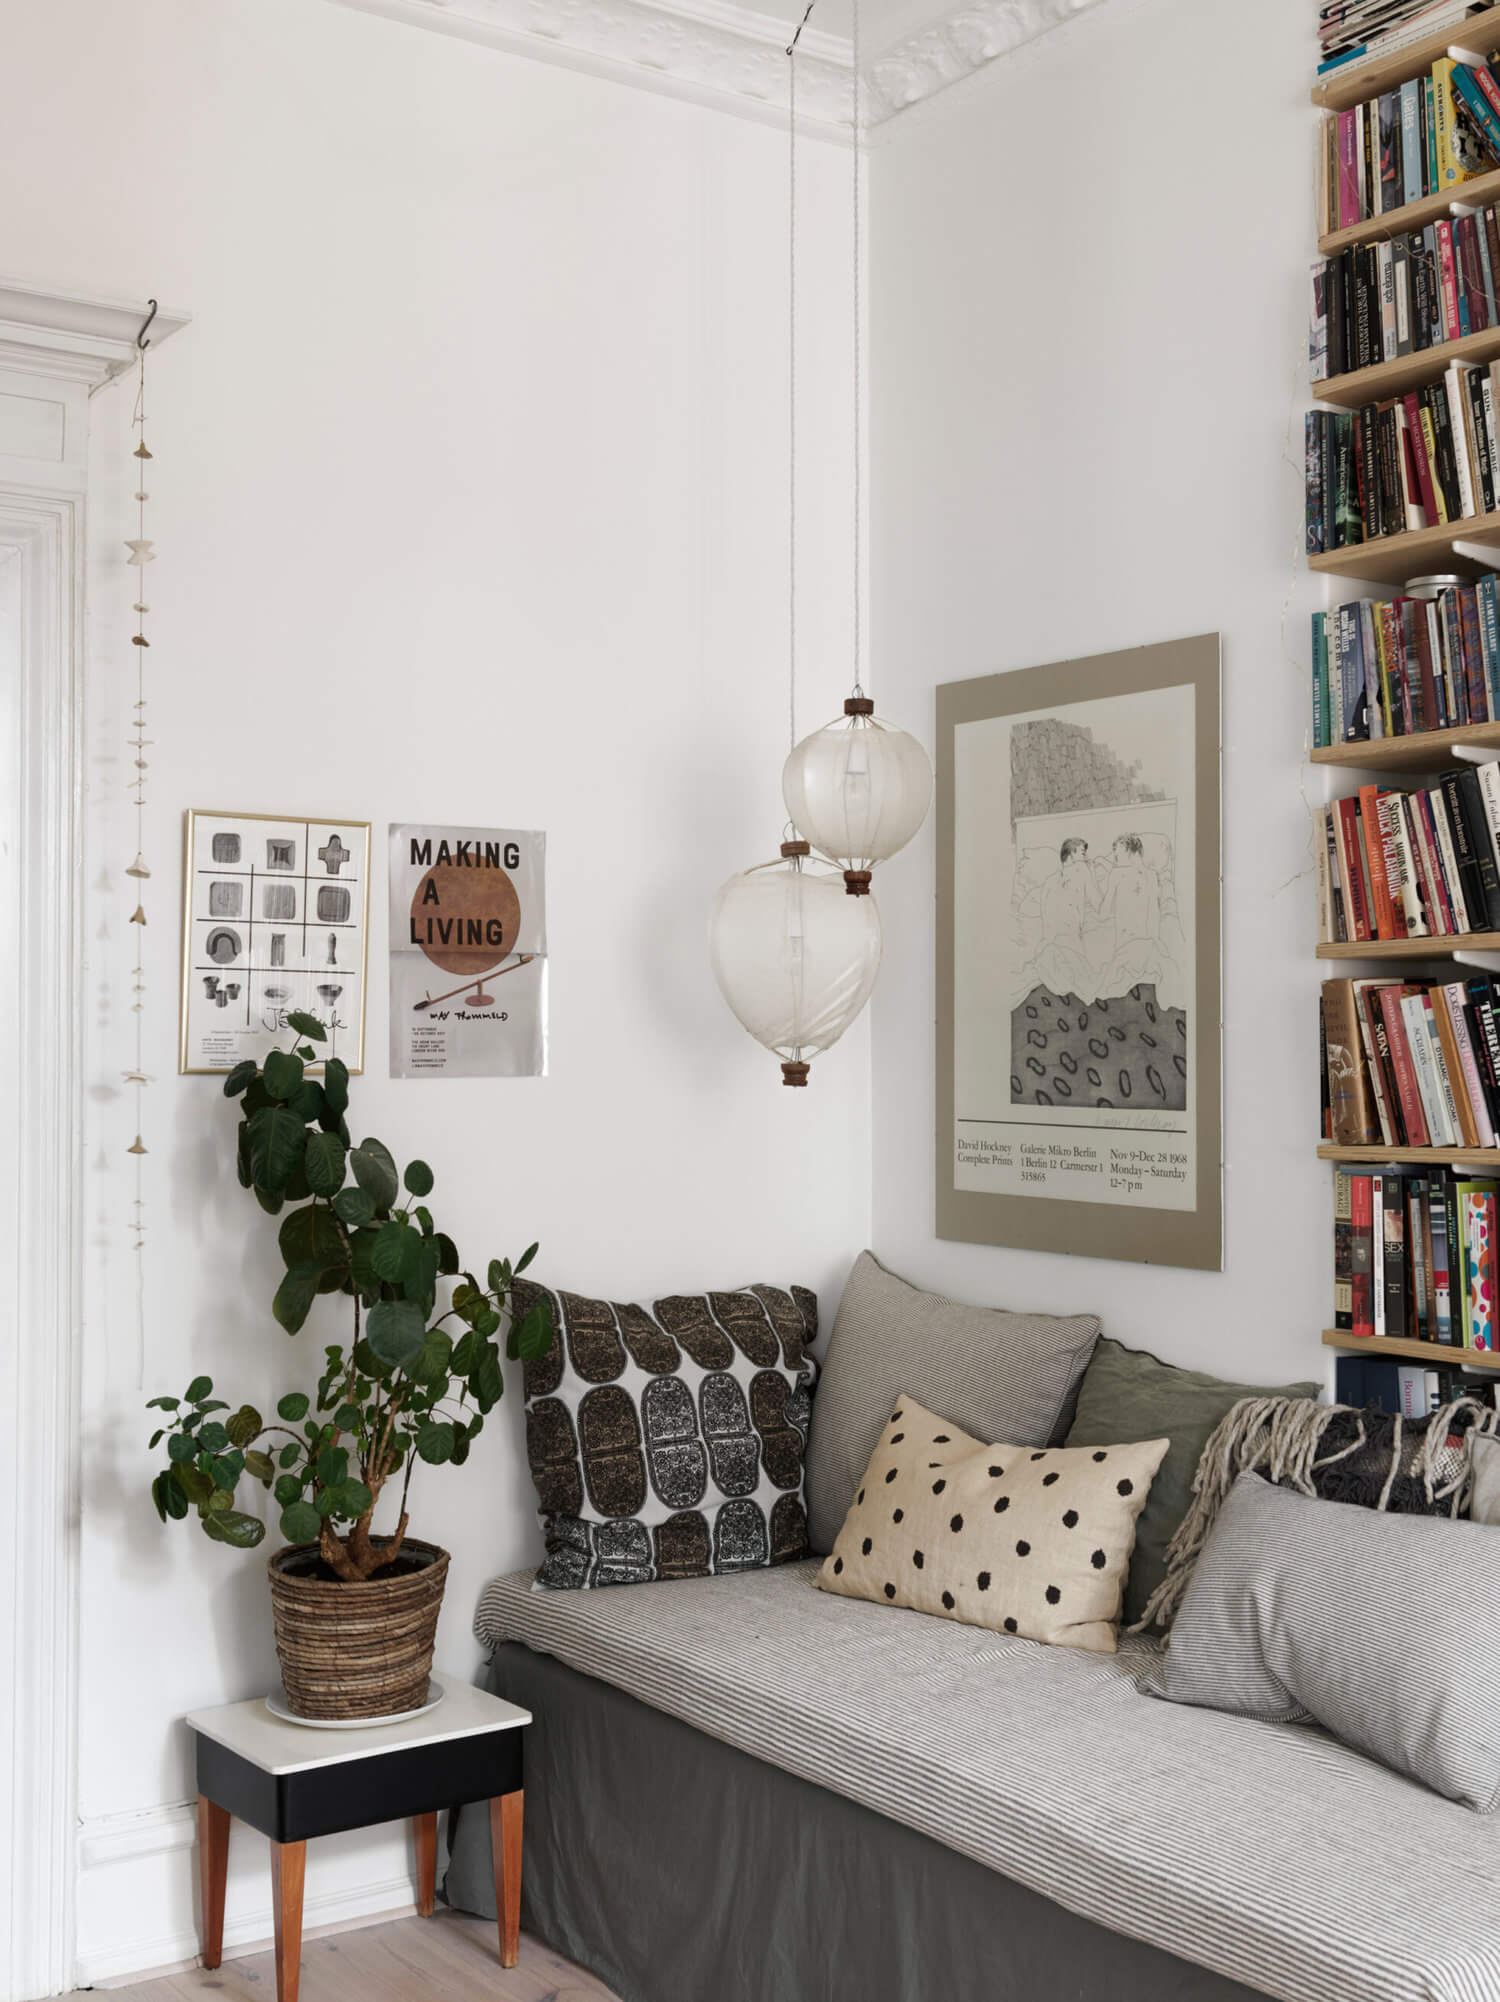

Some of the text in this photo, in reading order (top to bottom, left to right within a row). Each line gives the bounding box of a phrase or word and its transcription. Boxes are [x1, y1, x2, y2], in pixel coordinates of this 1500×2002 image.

[1383, 262, 1395, 303] och ekarna
[1489, 438, 1498, 473] MUSIC
[1338, 446, 1349, 494] American
[1485, 600, 1495, 625] JAMES
[1380, 607, 1400, 673] Atomised
[1488, 627, 1497, 652] ELLROY
[1484, 771, 1499, 830] Susan Faludi
[410, 838, 520, 869] MAKING
[1375, 798, 1403, 900] CHUCK PALAHNIUK
[422, 878, 441, 905] A
[410, 917, 503, 946] LIVING
[1447, 986, 1469, 1050] DORIS LESSING
[1375, 1023, 1390, 1057] SATAN
[1435, 1047, 1458, 1122] DYNAMIC FREEDOMS
[958, 1139, 1012, 1155] David Hockney
[958, 1153, 1013, 1166] Complete Prints
[1020, 1144, 1097, 1158] Galerie Mikro Berlin
[1110, 1149, 1128, 1160] Nov
[1157, 1153, 1168, 1163] 28
[1169, 1154, 1188, 1164] 1968
[1020, 1171, 1046, 1182] 315865
[1026, 1158, 1048, 1168] Berlin
[1050, 1160, 1058, 1169] 12
[1110, 1163, 1185, 1182] Monday Saturday
[1384, 1242, 1404, 1254] SEX
